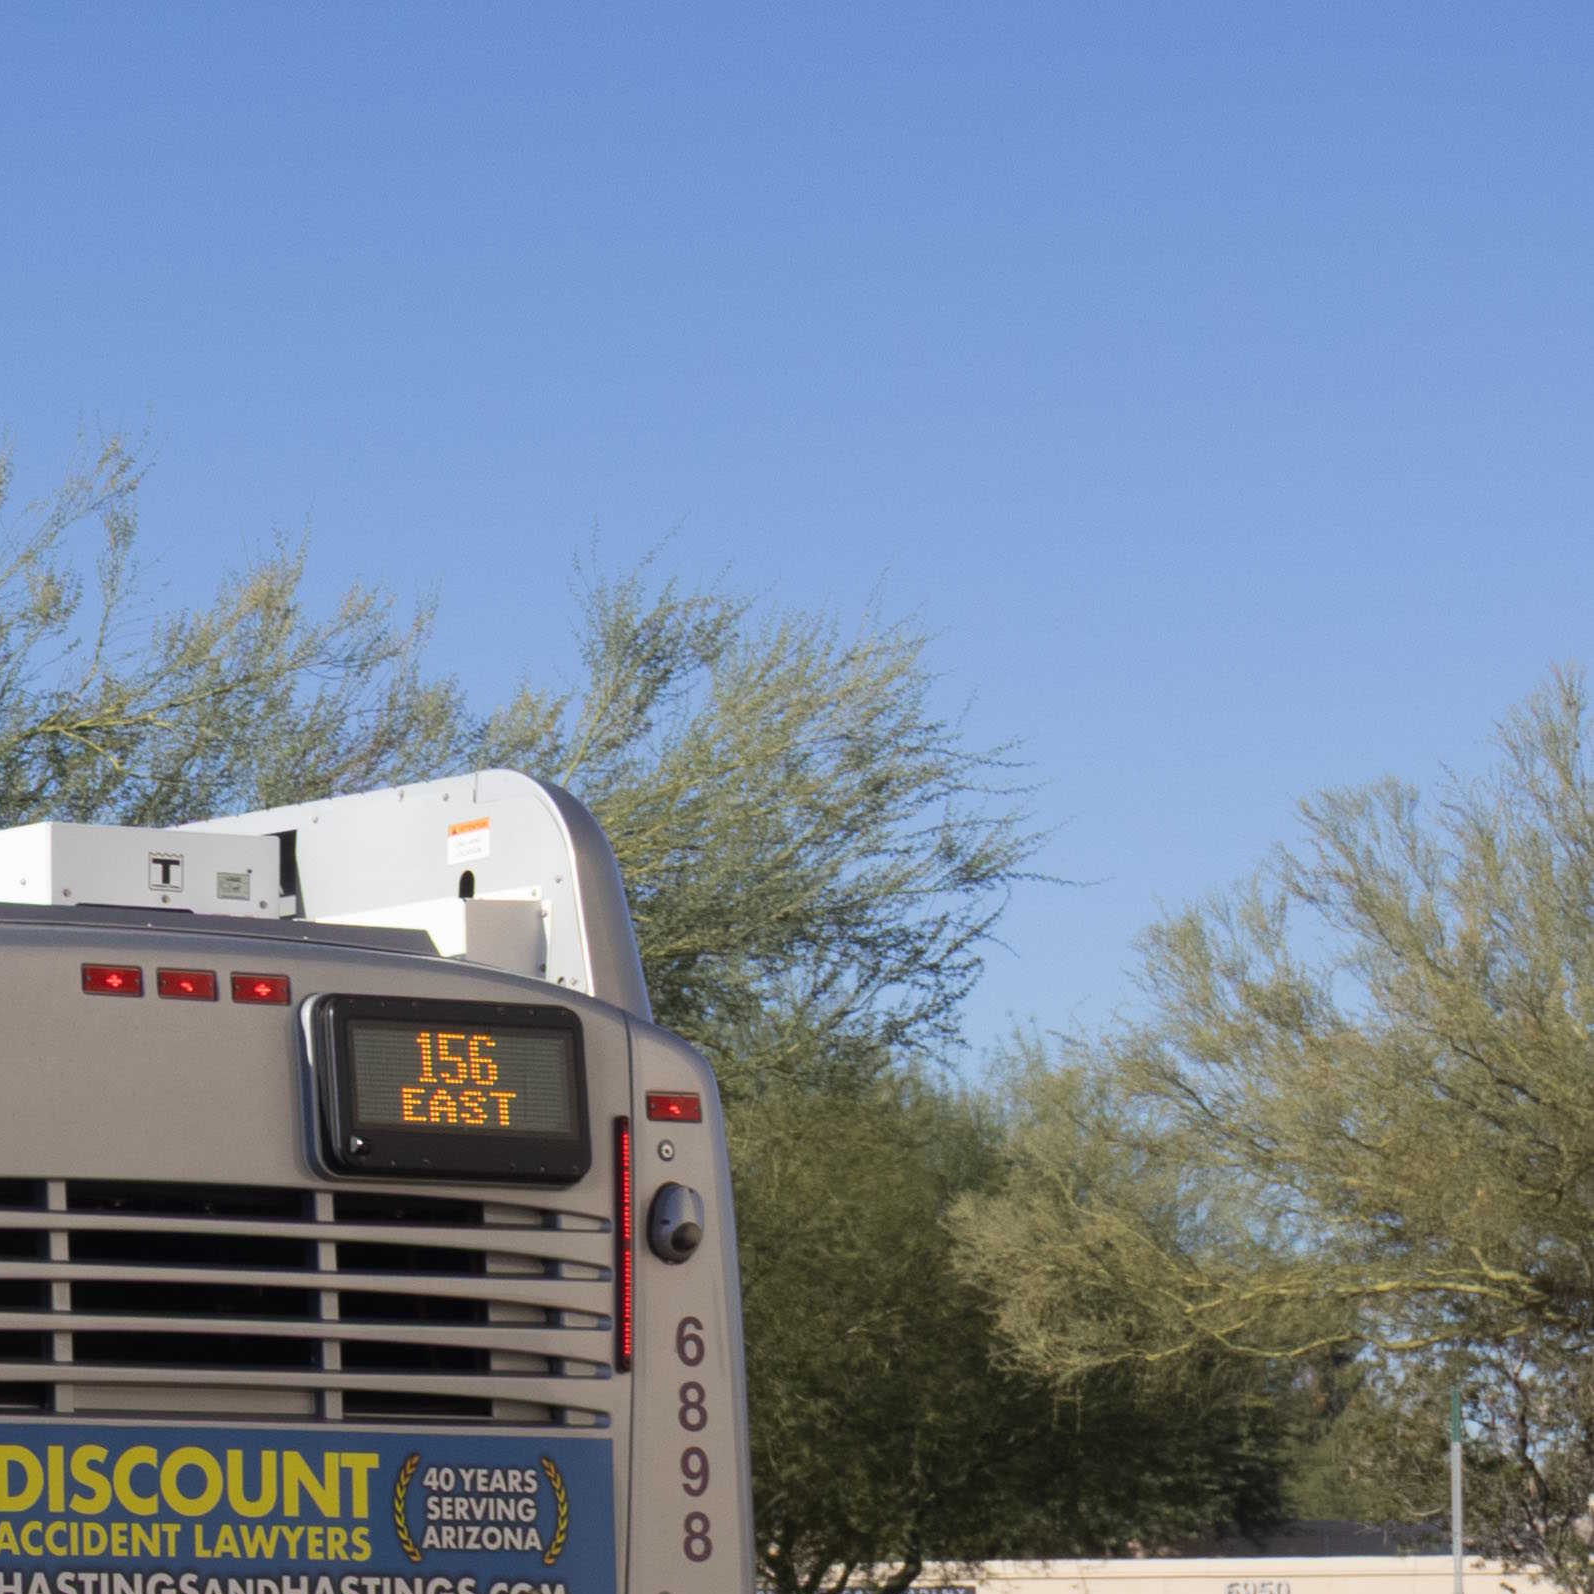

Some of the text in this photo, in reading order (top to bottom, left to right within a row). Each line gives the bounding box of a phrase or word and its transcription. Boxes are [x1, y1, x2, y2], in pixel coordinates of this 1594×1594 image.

[416, 1031, 499, 1087] 156
[401, 1086, 517, 1127] EAST
[675, 1315, 714, 1563] 6898
[422, 1467, 539, 1494] 40 YEARS
[426, 1497, 537, 1523] SERVING
[194, 1523, 373, 1562] LAWYERS
[421, 1526, 543, 1551] ARIZONA
